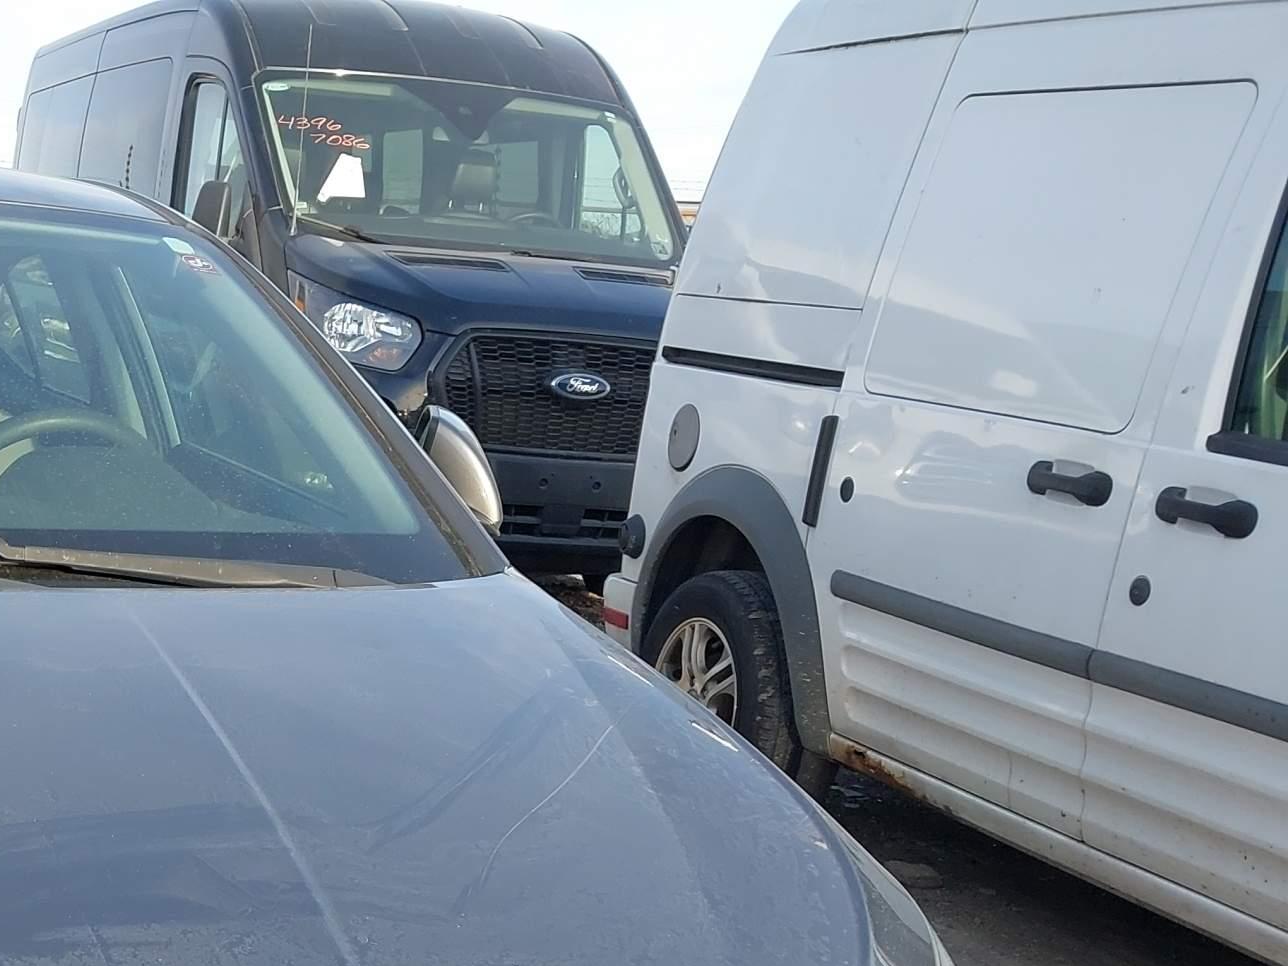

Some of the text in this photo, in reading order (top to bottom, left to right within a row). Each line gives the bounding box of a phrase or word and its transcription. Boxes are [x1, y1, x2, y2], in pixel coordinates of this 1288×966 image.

[278, 115, 342, 131] 4396
[310, 133, 370, 149] 7086
[567, 377, 599, 393] Ford
